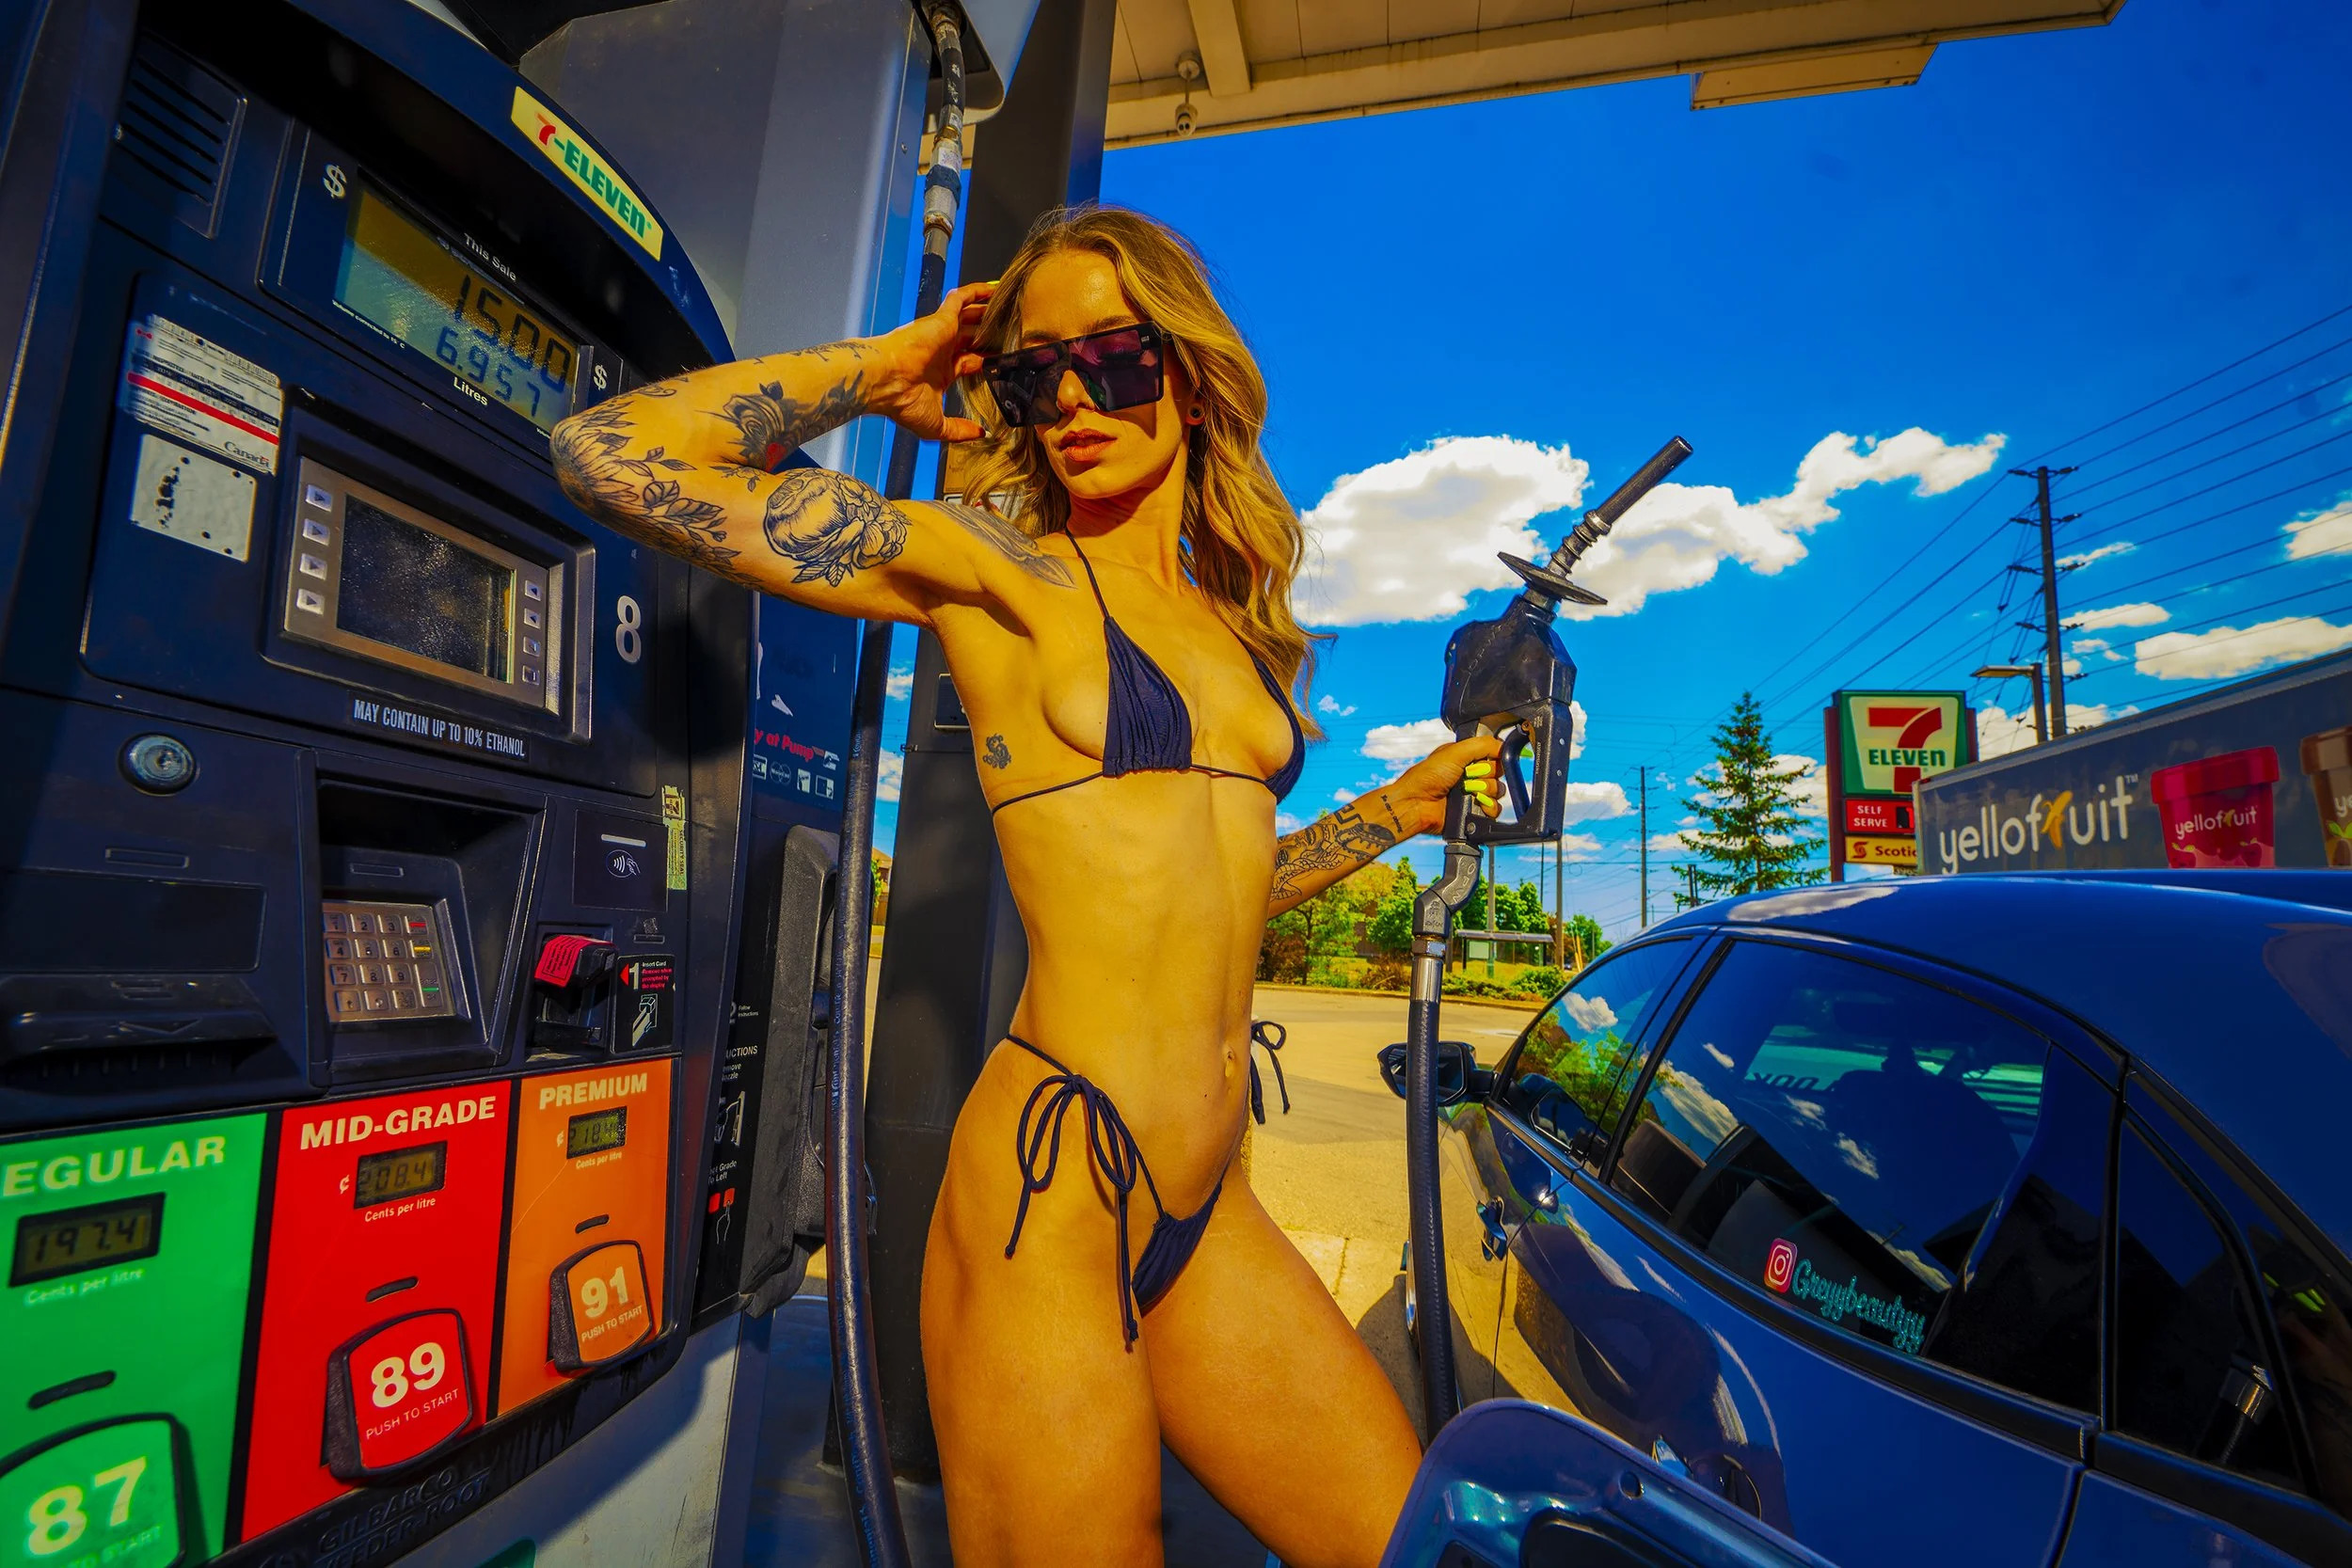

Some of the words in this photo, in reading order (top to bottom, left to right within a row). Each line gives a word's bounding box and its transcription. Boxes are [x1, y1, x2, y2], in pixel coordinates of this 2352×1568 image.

[323, 164, 347, 198] $
[464, 232, 489, 261] This
[492, 256, 516, 281] Sale
[436, 325, 541, 418] 6.957
[594, 364, 608, 390] $
[453, 376, 489, 406] Litres
[224, 441, 270, 467] Canada
[615, 595, 642, 664] 8
[354, 699, 380, 722] MAY
[382, 706, 429, 736] CONTAIN
[432, 719, 446, 738] UP
[448, 722, 461, 742] TO
[464, 726, 483, 748] 10%
[486, 731, 525, 757] ETHANOL
[766, 734, 780, 748] at
[782, 735, 815, 763] Pump
[1868, 706, 1943, 793] 7
[1853, 817, 1888, 828] SERVE
[1857, 805, 1882, 815] SELF
[360, 922, 368, 931] 2
[389, 922, 395, 931] 3
[629, 962, 639, 990] 1
[539, 1072, 647, 1110] PREMIUM
[300, 1096, 497, 1150] MID-GRADE
[576, 1157, 596, 1170] Cents
[596, 1155, 608, 1166] per
[609, 1150, 623, 1161] litre
[716, 1171, 728, 1182] Left
[719, 1160, 738, 1172] Grade
[364, 1207, 394, 1223] Cents
[397, 1203, 414, 1216] per
[417, 1196, 437, 1210] litre
[27, 1284, 75, 1305] Cents
[81, 1275, 107, 1296] per
[112, 1269, 143, 1284] litre
[580, 1266, 628, 1319] 91
[580, 1323, 605, 1342] PUSH
[606, 1318, 617, 1330] TO
[618, 1305, 643, 1324] START
[371, 1342, 446, 1408] 89
[366, 1417, 400, 1440] PUSH
[404, 1407, 420, 1421] TO
[422, 1388, 459, 1413] START
[27, 1455, 148, 1556] 87
[320, 1465, 455, 1554] GILBARCO
[101, 1526, 161, 1563] START
